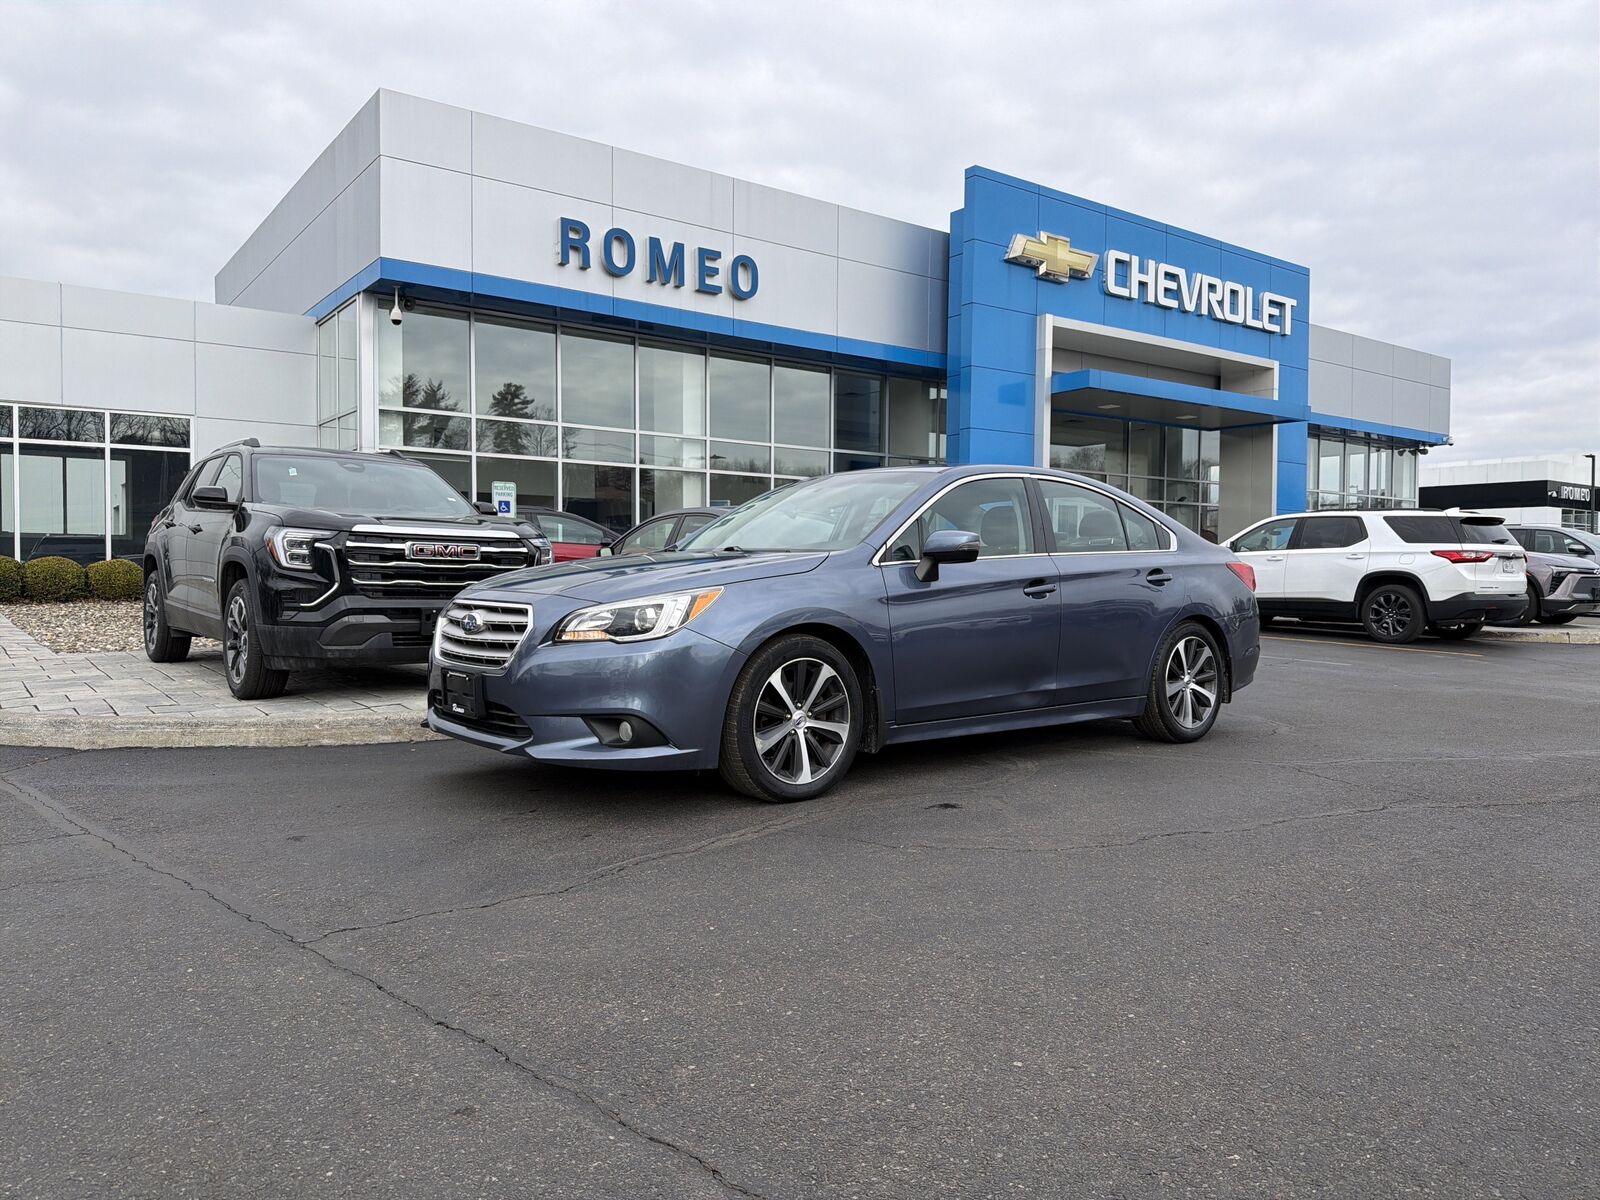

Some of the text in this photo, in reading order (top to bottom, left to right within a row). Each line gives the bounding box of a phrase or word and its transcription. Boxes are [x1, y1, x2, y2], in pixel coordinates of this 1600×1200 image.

[557, 216, 760, 301] ROMEO
[1104, 249, 1297, 336] CHEVROLET
[1560, 485, 1590, 502] ROMEO
[413, 544, 478, 559] GMC
